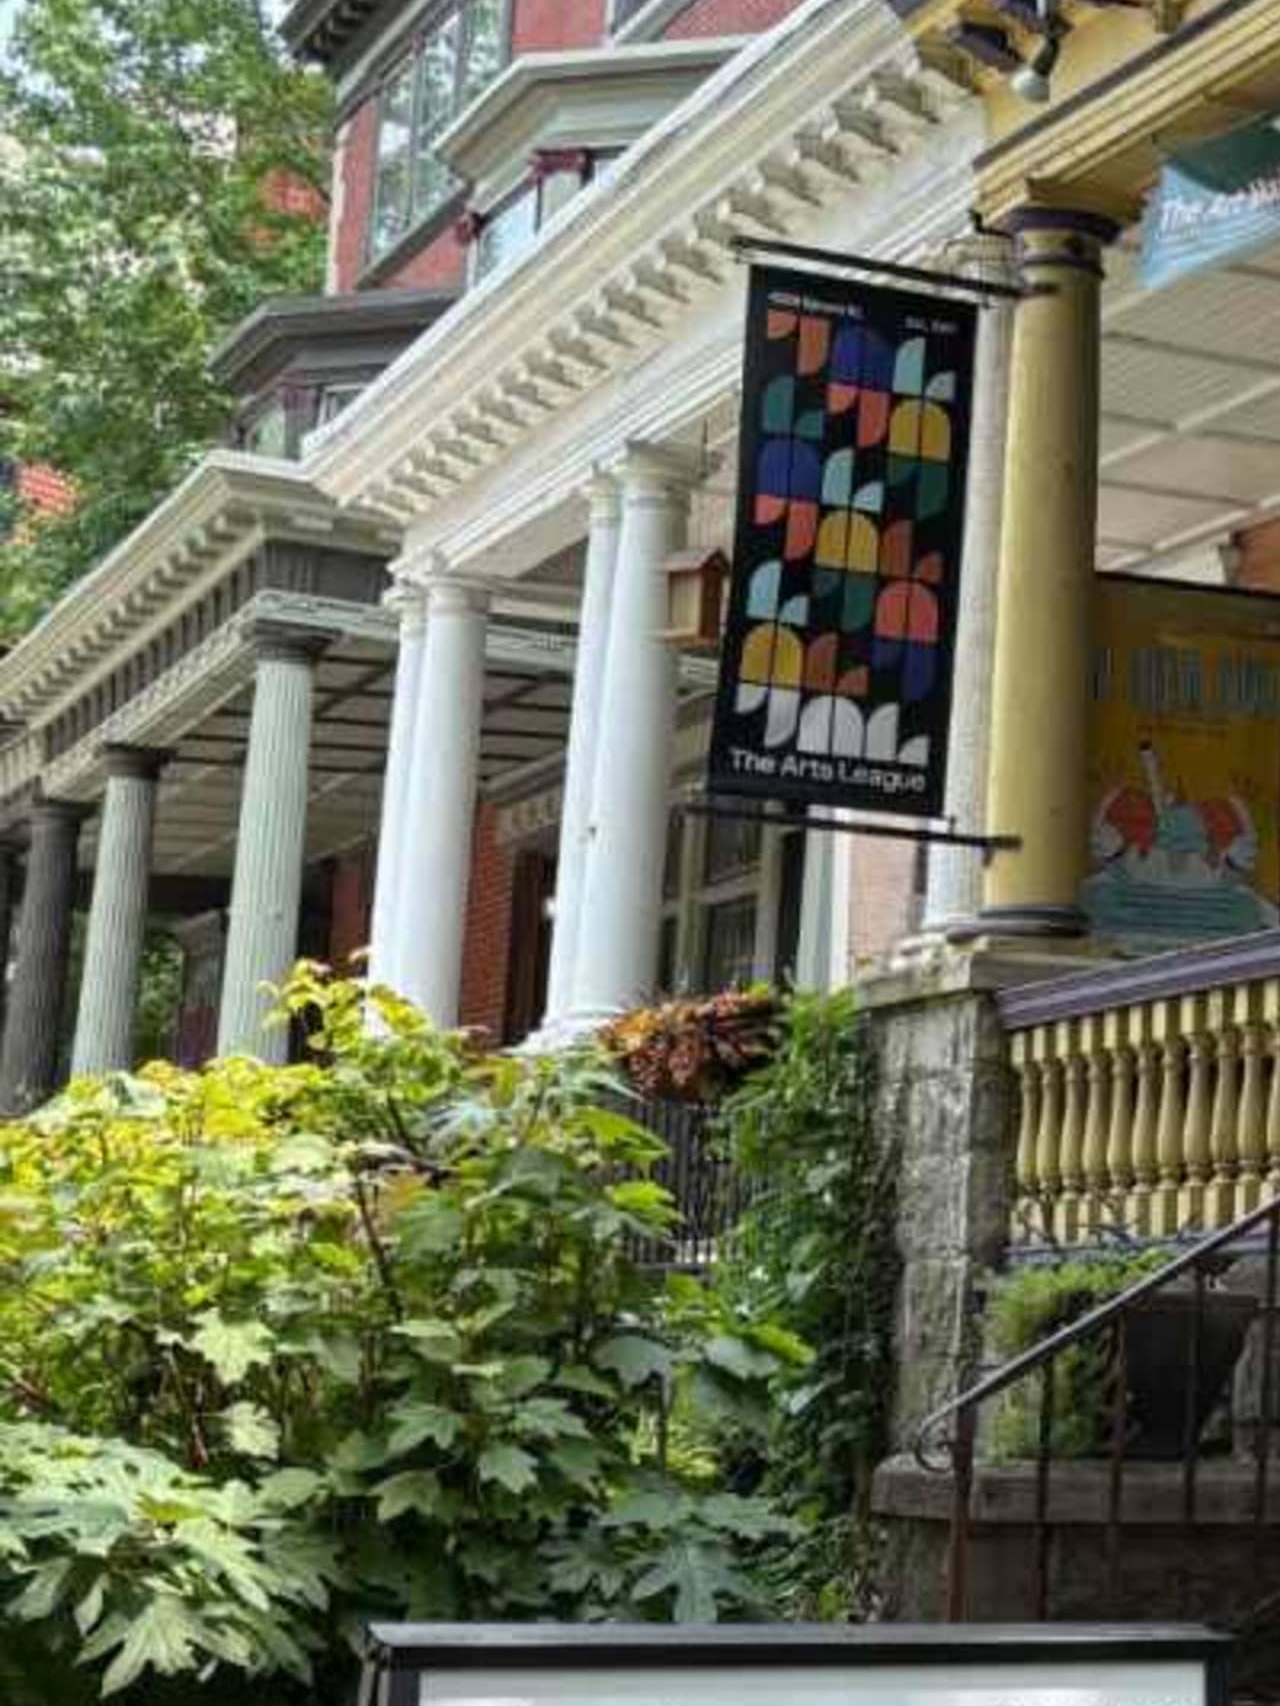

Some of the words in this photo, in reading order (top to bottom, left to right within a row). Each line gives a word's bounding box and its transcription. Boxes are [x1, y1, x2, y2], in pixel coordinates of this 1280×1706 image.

[729, 746, 777, 775] The
[780, 754, 834, 782] Arts
[838, 759, 927, 794] League
